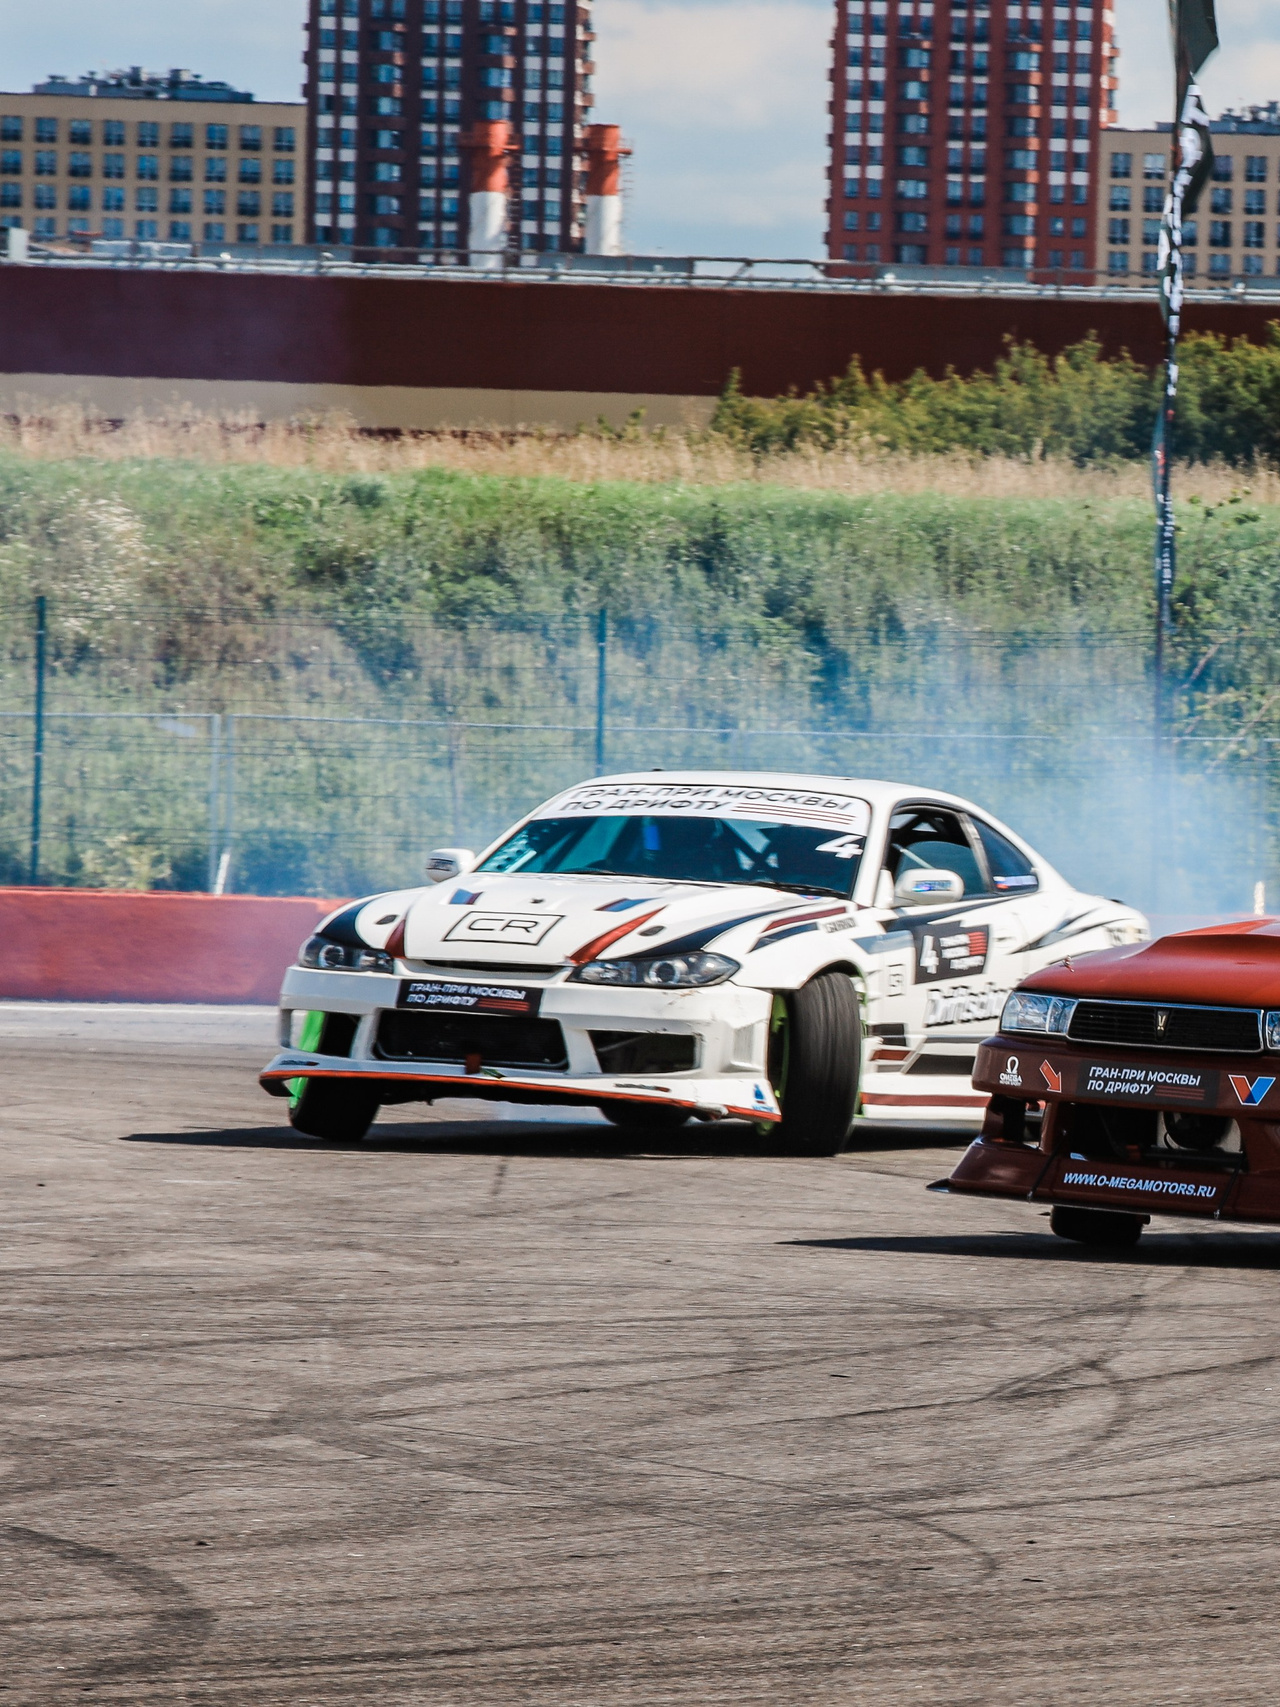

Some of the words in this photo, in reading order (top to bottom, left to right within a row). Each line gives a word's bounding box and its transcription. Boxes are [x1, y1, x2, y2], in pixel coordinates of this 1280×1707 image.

[560, 800, 601, 811] ПО
[604, 800, 730, 811] ДРИФТУ
[570, 787, 713, 799] ГРАН-ПРИ
[716, 788, 853, 811] МОСКВЫ
[815, 835, 864, 859] 4
[467, 917, 540, 933] CR
[919, 934, 940, 974] 4
[406, 993, 426, 1004] ПО
[426, 995, 479, 1007] ДРИФТУ
[408, 982, 468, 995] ГРАН-ПРИ
[469, 985, 527, 1001] МОСКВЫ
[1088, 1066, 1148, 1082] ГРАН-ПРИ
[1149, 1070, 1201, 1087] МОСКВЫ
[1086, 1079, 1104, 1091] ПО
[1104, 1081, 1154, 1096] ДРИФТУ
[1062, 1172, 1217, 1199] WWW.O-MEGAMOTORS.RU
